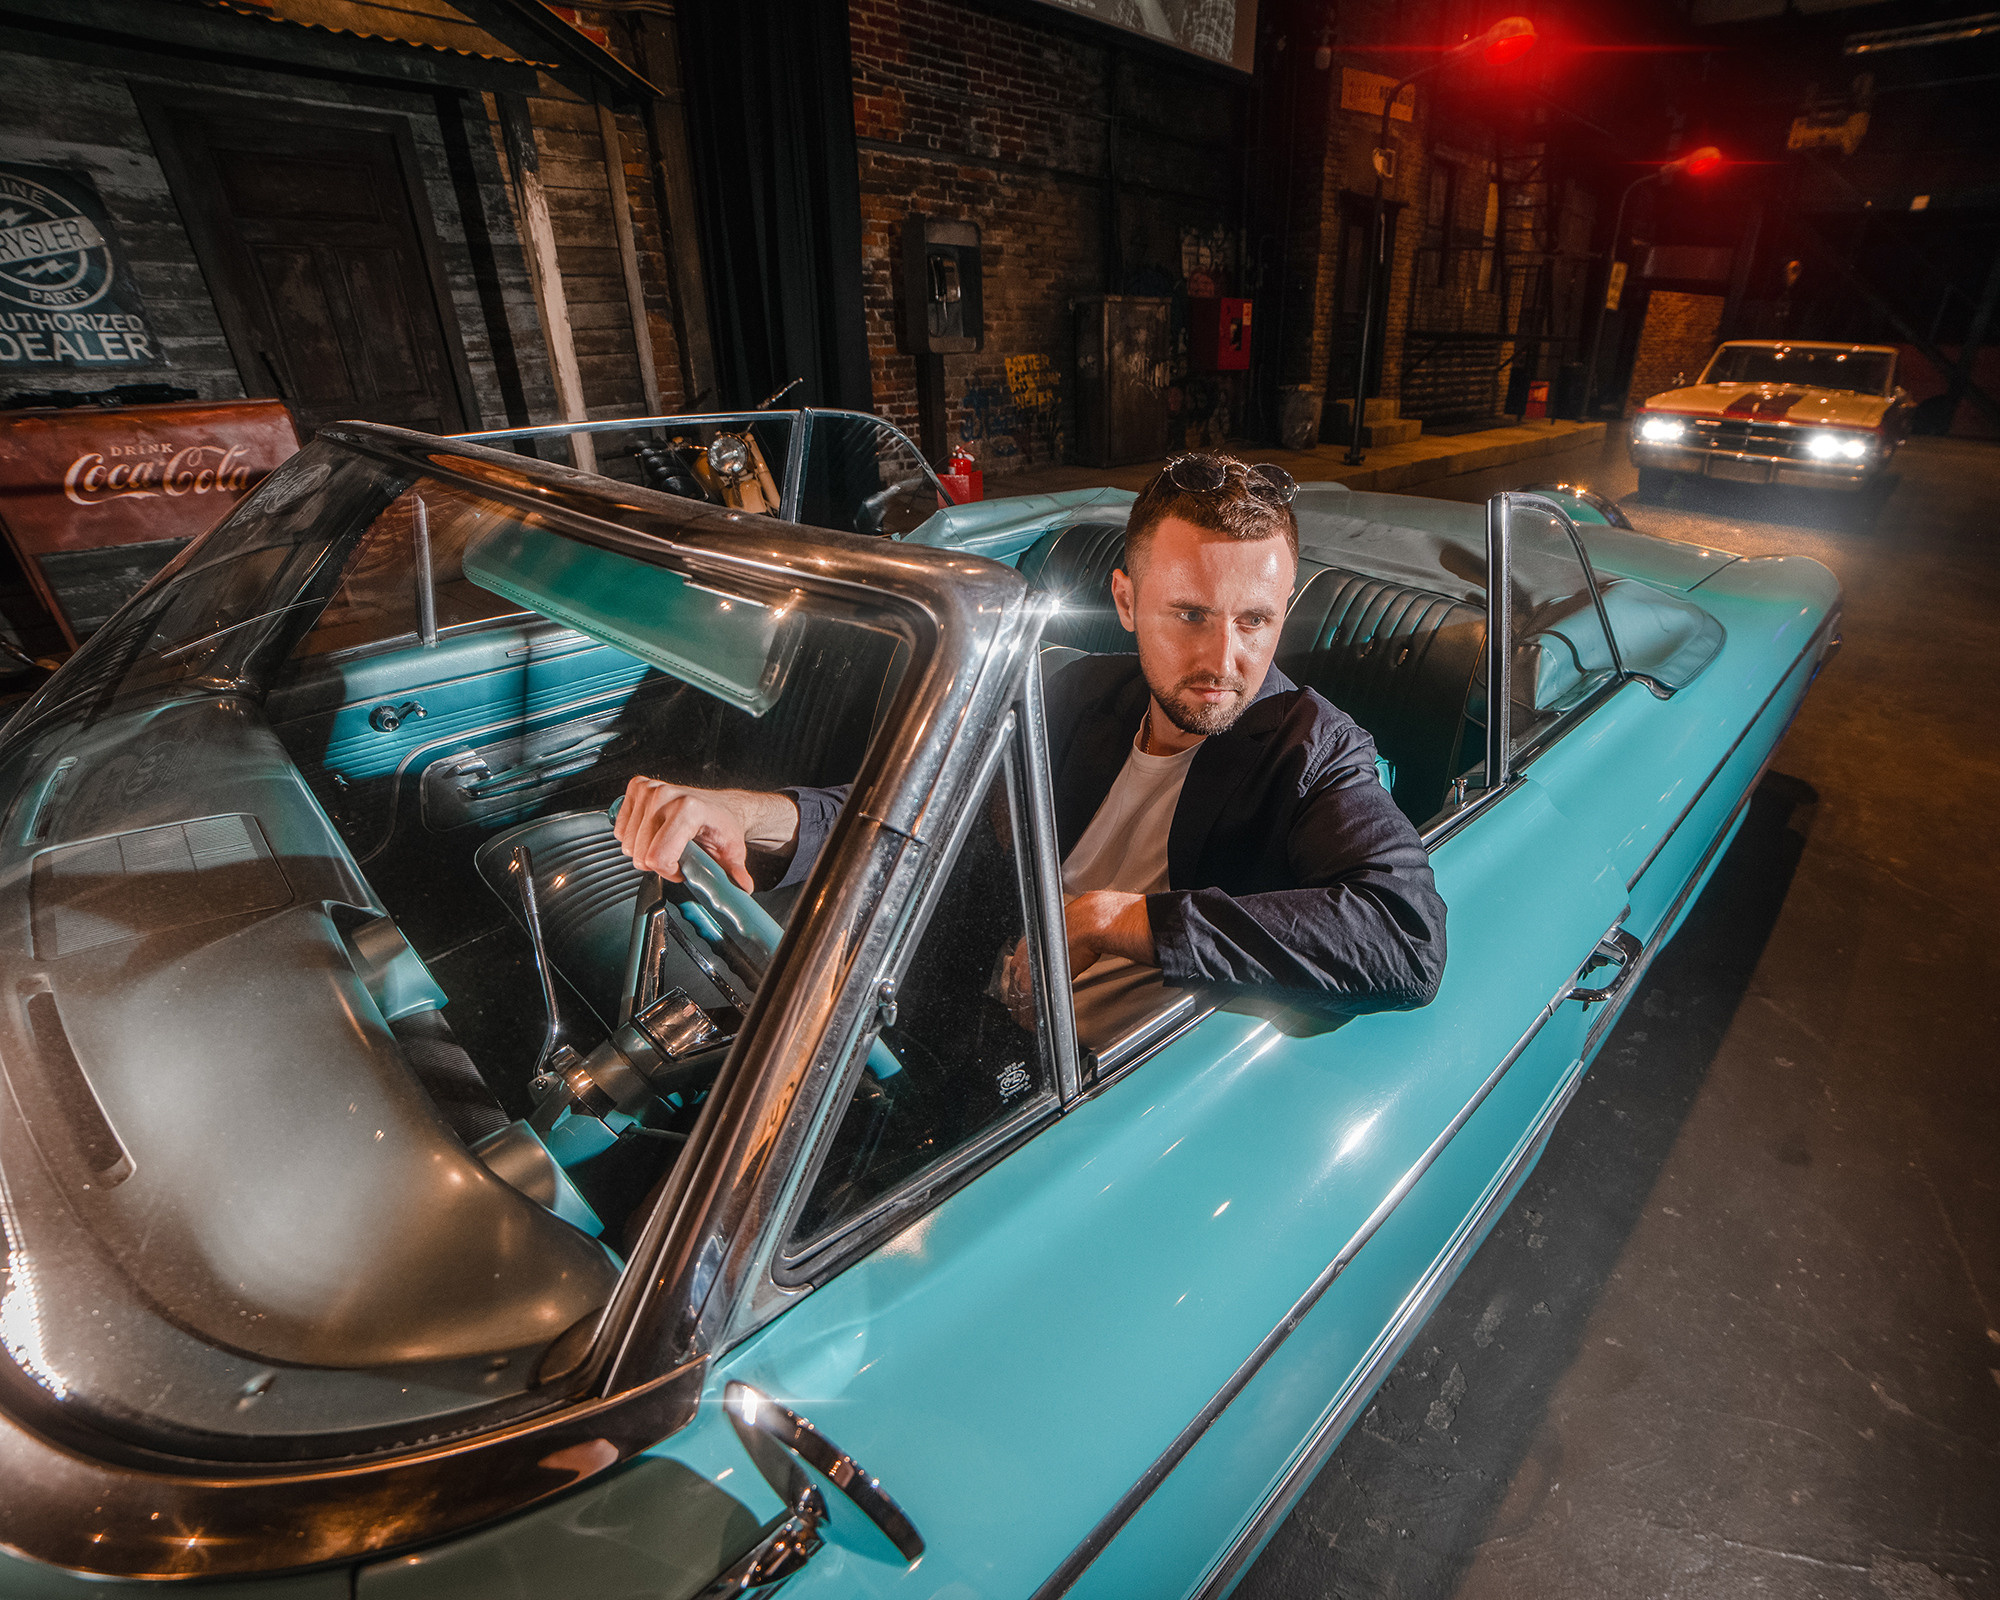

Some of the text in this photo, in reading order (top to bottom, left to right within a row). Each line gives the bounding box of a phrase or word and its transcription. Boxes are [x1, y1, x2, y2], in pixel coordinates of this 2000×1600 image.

[29, 286, 90, 305] PARTS
[0, 312, 144, 332] UTHORIZED
[110, 443, 174, 457] DRINK
